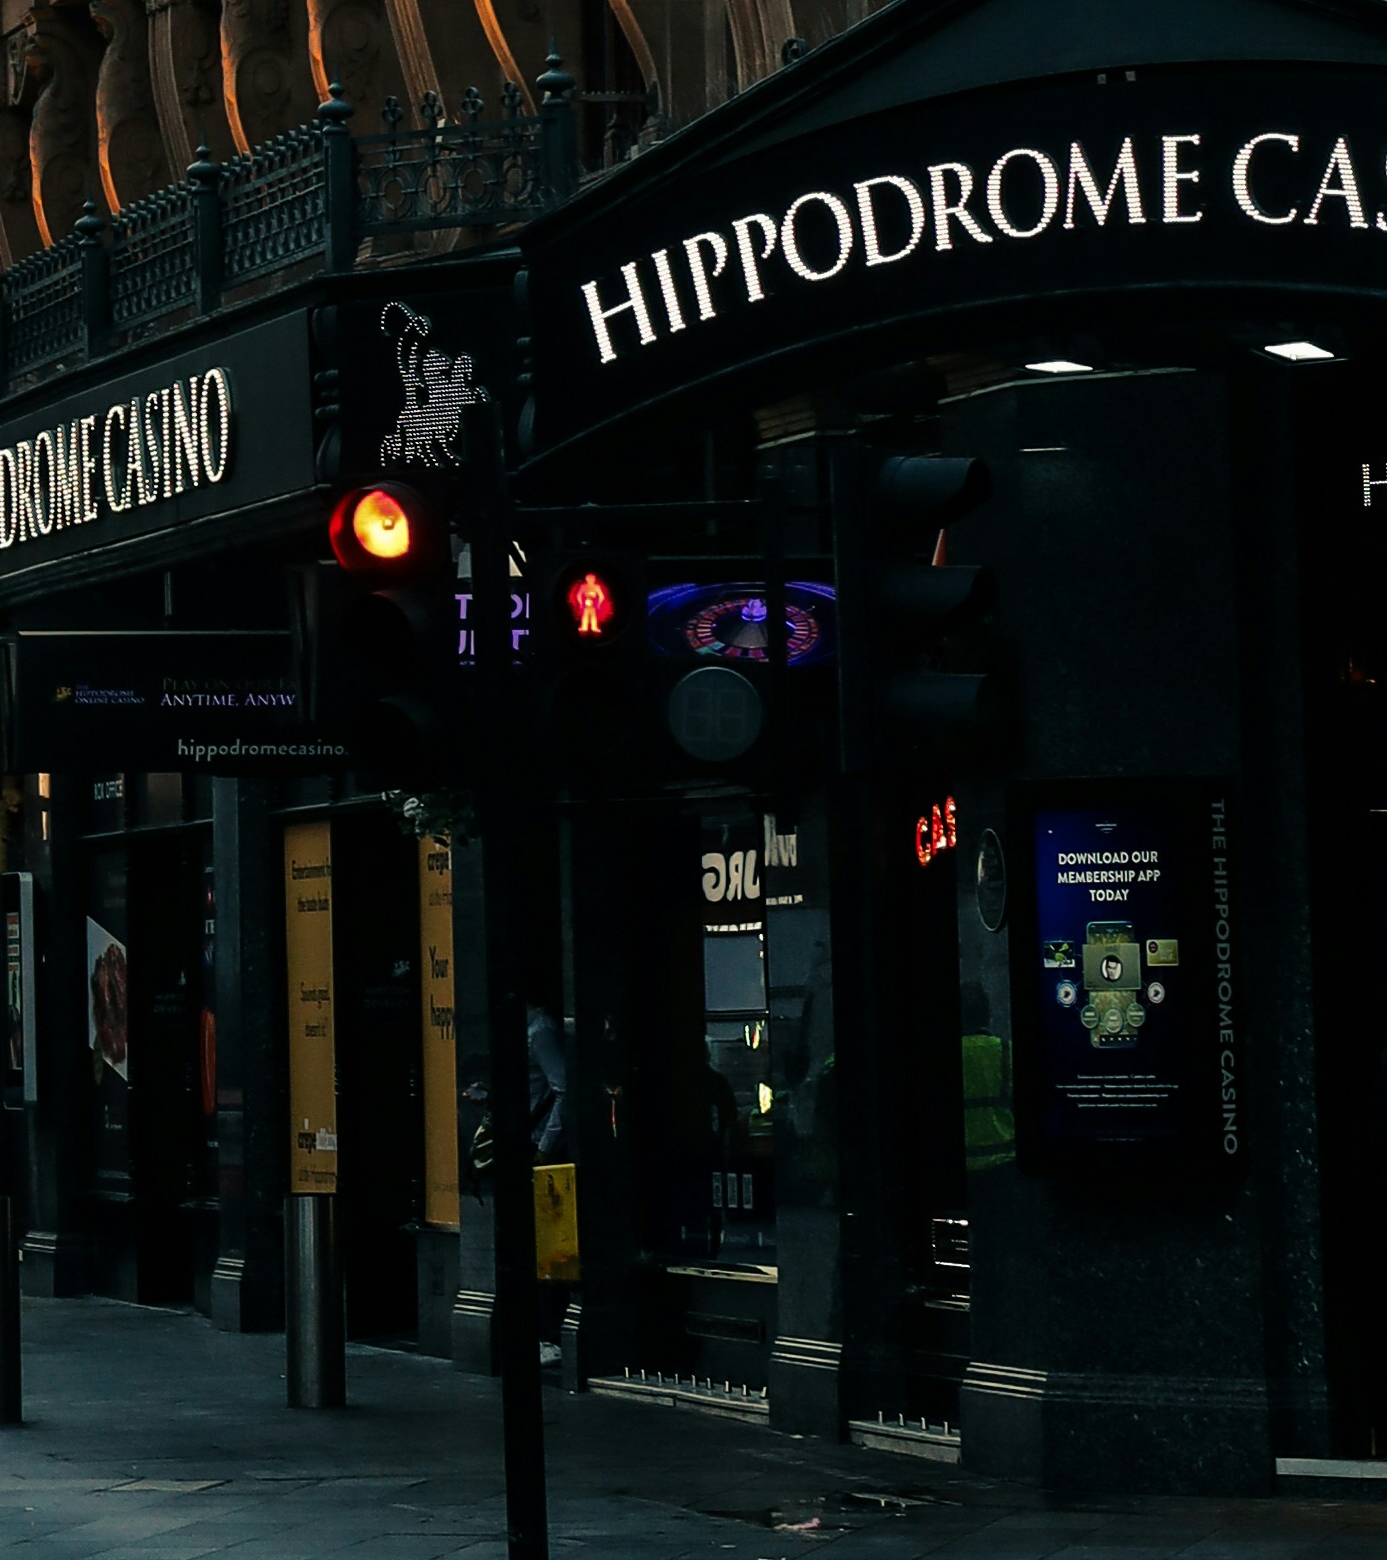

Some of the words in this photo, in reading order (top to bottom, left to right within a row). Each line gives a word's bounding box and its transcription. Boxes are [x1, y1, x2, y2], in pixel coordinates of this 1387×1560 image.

[580, 133, 1203, 364] HIPPODROME
[1232, 131, 1387, 230] CA
[103, 367, 230, 513] CASINO
[1058, 851, 1129, 865] DOWNLOAD
[1131, 850, 1158, 863] OUR
[1211, 799, 1226, 849] THE
[1057, 870, 1135, 883] MEMBERSHIP
[1138, 869, 1161, 882] APP
[1089, 889, 1129, 901] TODAY
[1213, 857, 1234, 1043] HIPPODROME
[1220, 1050, 1238, 1155] CASINO
